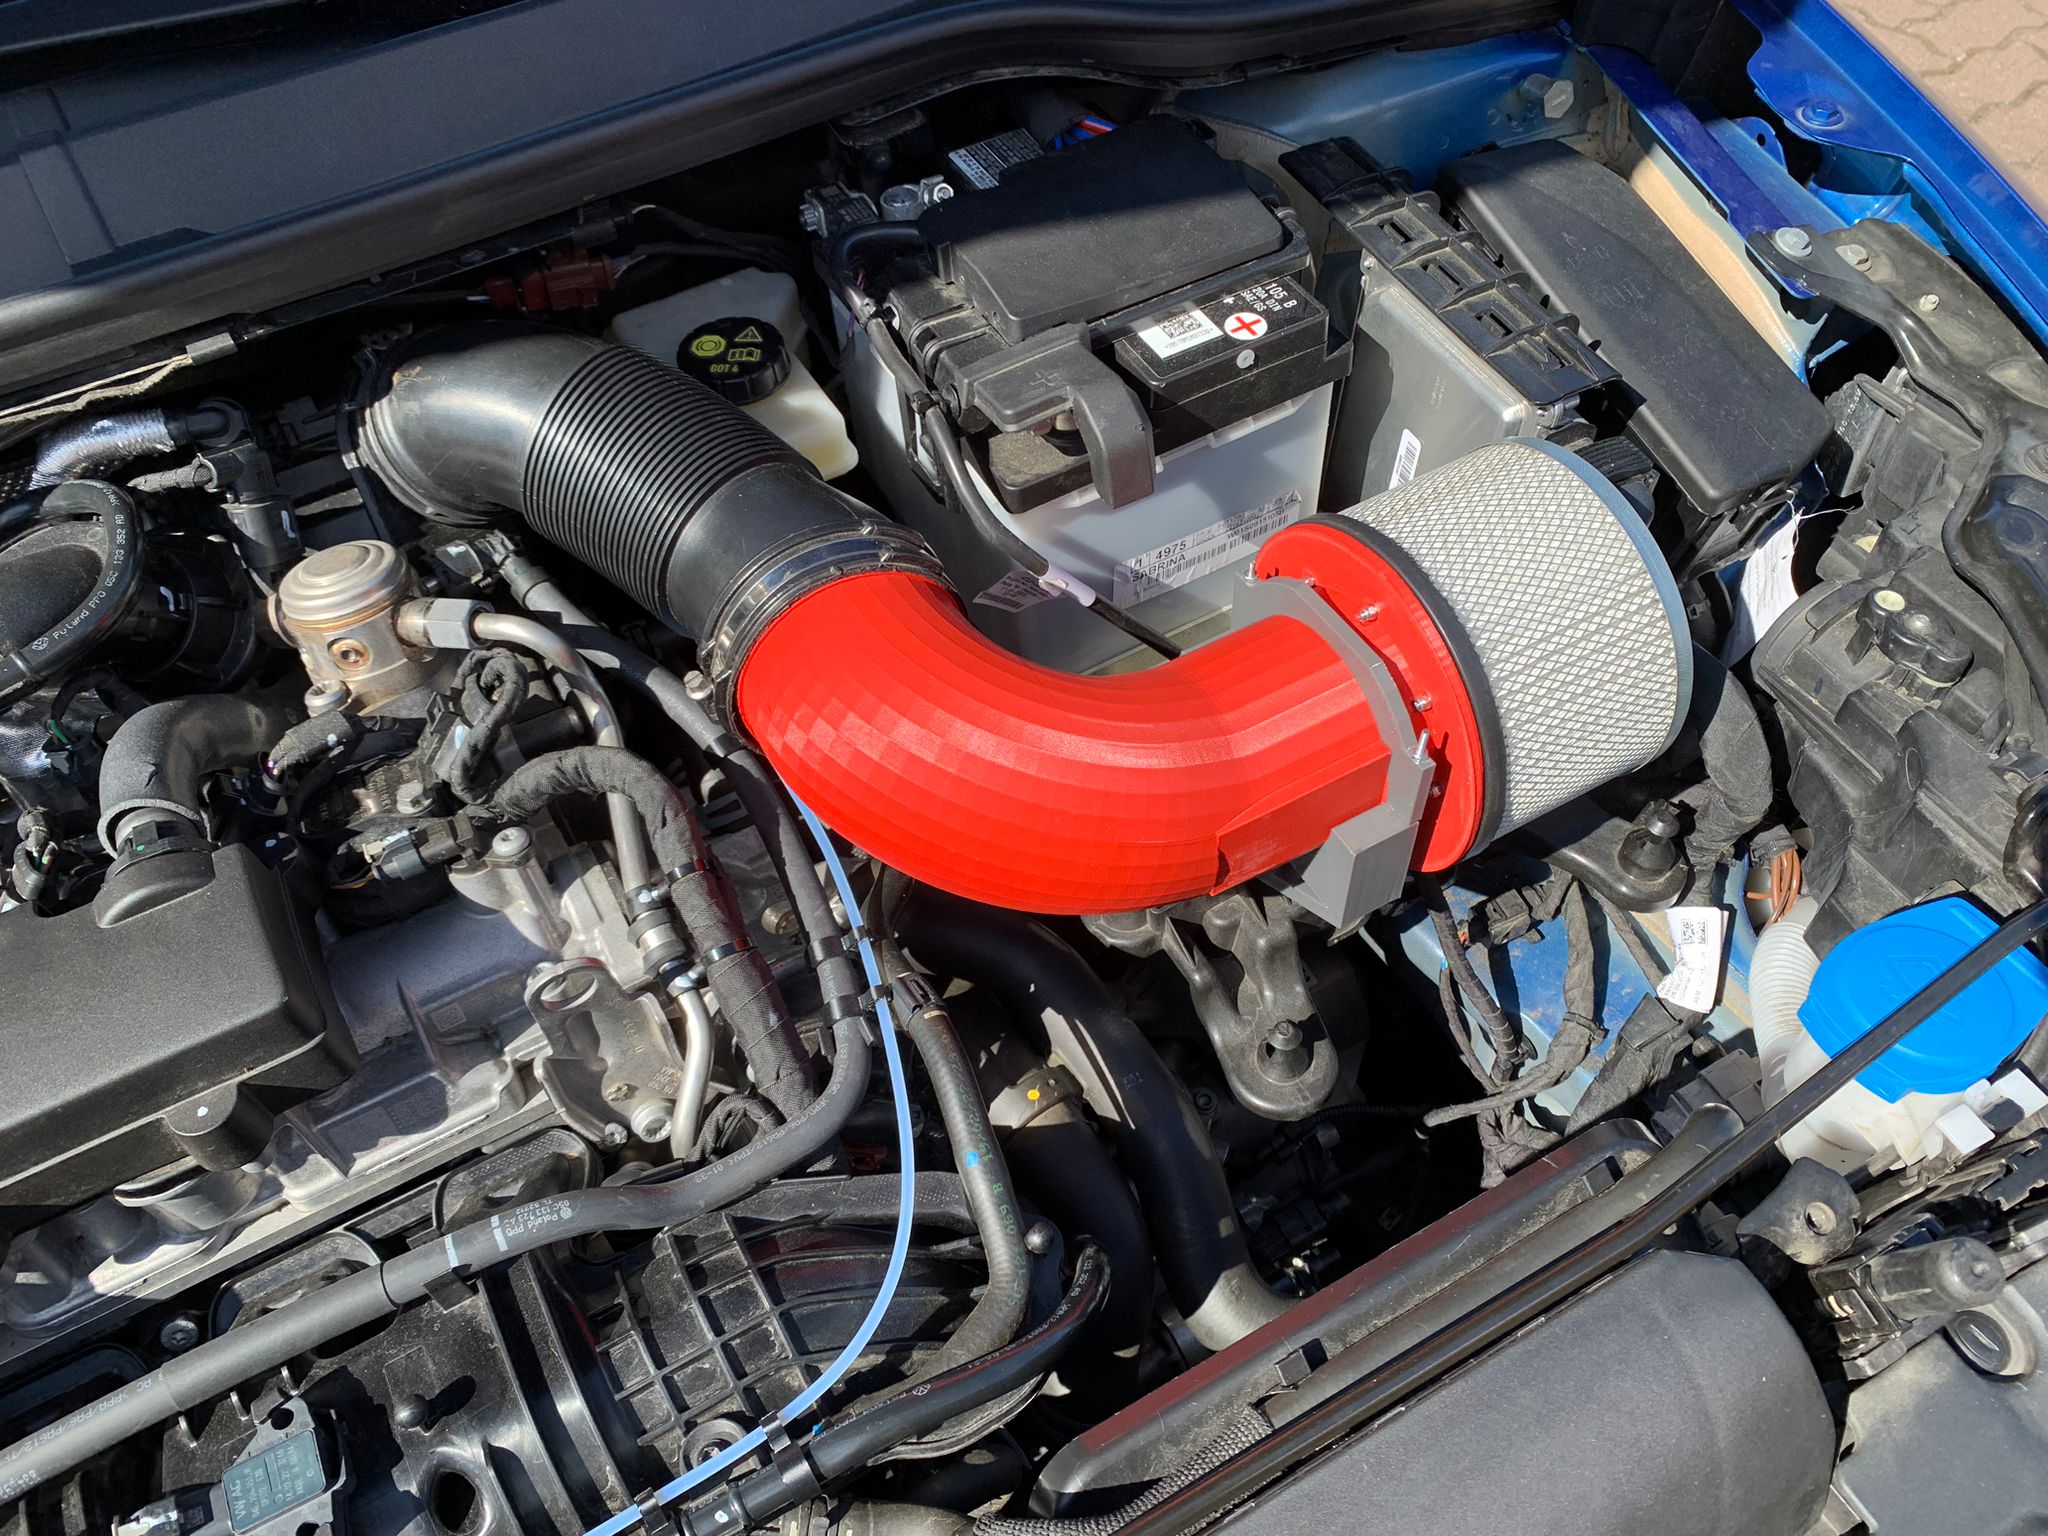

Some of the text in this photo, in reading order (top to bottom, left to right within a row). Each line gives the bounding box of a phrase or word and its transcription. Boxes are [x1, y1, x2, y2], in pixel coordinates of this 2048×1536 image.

[1265, 282, 1298, 308] 105 B
[1265, 298, 1283, 312] DIN
[709, 363, 739, 373] DOT 4
[115, 528, 126, 545] 352
[113, 549, 125, 565] 133
[1155, 540, 1187, 560] 4975
[1131, 553, 1187, 582] SABRINA
[822, 963, 839, 997] Poland
[992, 1182, 1004, 1194] B
[536, 1205, 552, 1215] 133
[553, 1199, 570, 1211] 05C
[505, 1212, 558, 1237] Poland PPO
[518, 1211, 533, 1223] 723
[229, 1479, 247, 1520] VW AG
